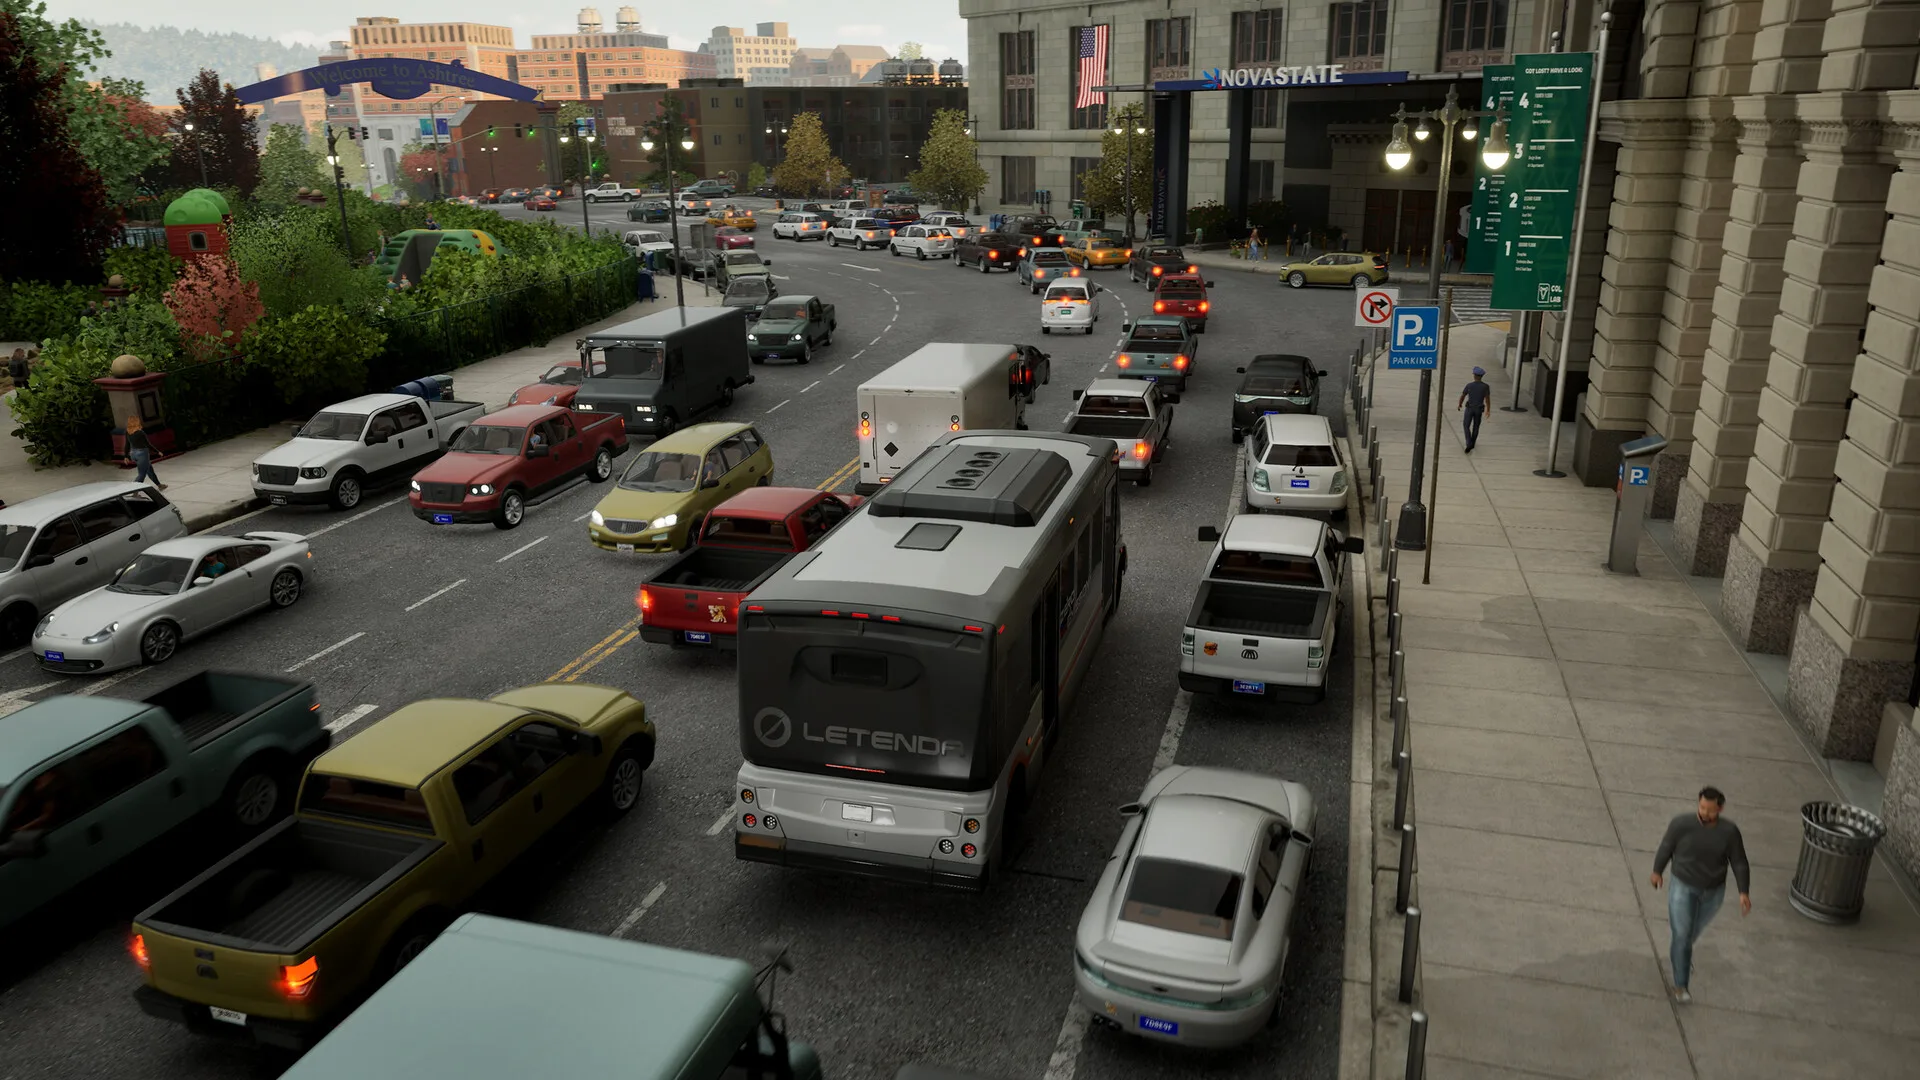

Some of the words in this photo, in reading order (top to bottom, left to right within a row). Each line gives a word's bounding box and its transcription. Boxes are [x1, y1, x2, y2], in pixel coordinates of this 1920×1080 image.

[308, 64, 387, 85] Welcome
[393, 65, 410, 77] to
[416, 64, 476, 87] Ashtree
[1221, 64, 1344, 87] NOVASTATE
[1486, 96, 1495, 109] 4
[1519, 92, 1529, 108] 4
[1514, 143, 1523, 159] 3
[1479, 177, 1486, 190] 2
[1509, 192, 1518, 208] 2
[1475, 217, 1481, 230] 1
[1505, 241, 1511, 256] 1
[1397, 314, 1423, 346] P
[1415, 336, 1433, 346] 24h
[1392, 357, 1433, 365] PARKING
[1630, 469, 1644, 483] P
